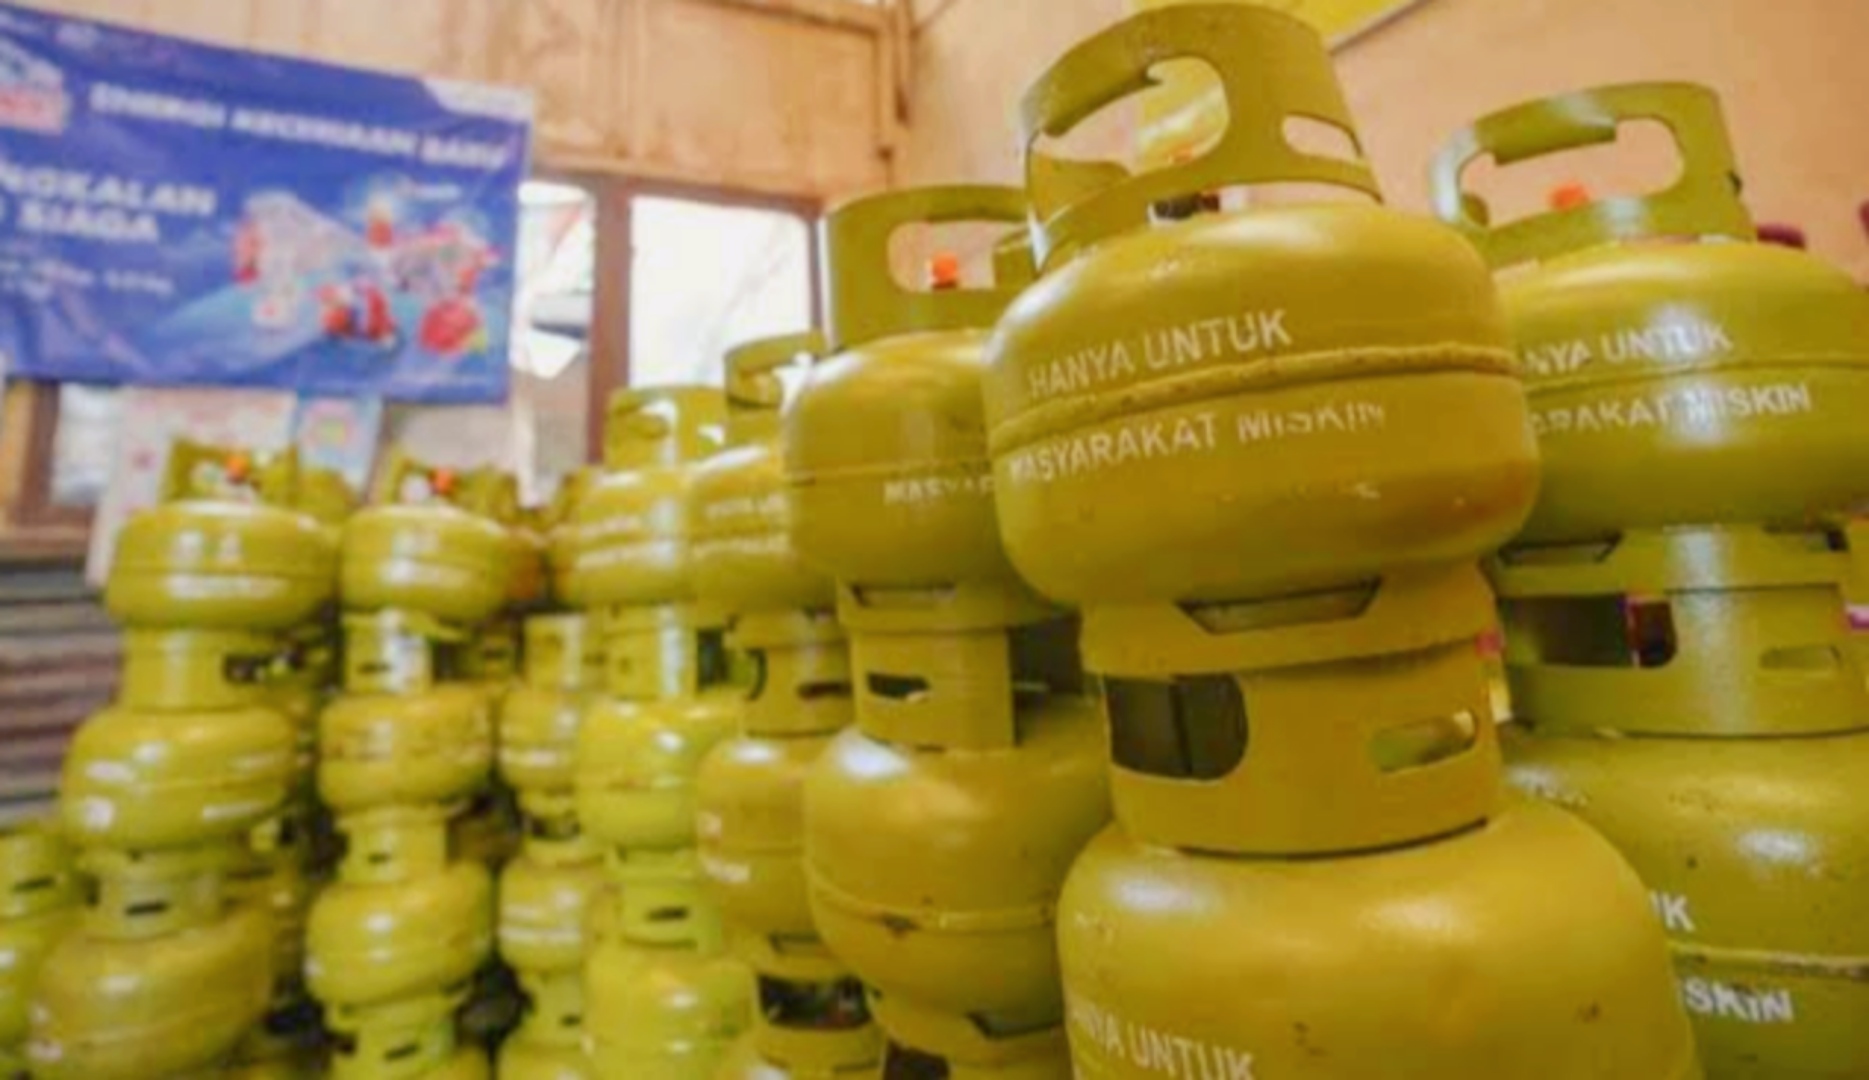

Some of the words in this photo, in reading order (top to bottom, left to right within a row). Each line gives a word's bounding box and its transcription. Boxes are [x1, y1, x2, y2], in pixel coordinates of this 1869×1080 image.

[1028, 339, 1135, 398] HANYA
[1144, 309, 1292, 369] UNTUK
[1600, 323, 1734, 364] UNTUK
[1682, 383, 1812, 423] MISKIN
[1009, 411, 1216, 485] MASYARAKAT
[1237, 402, 1385, 443] MISKIN
